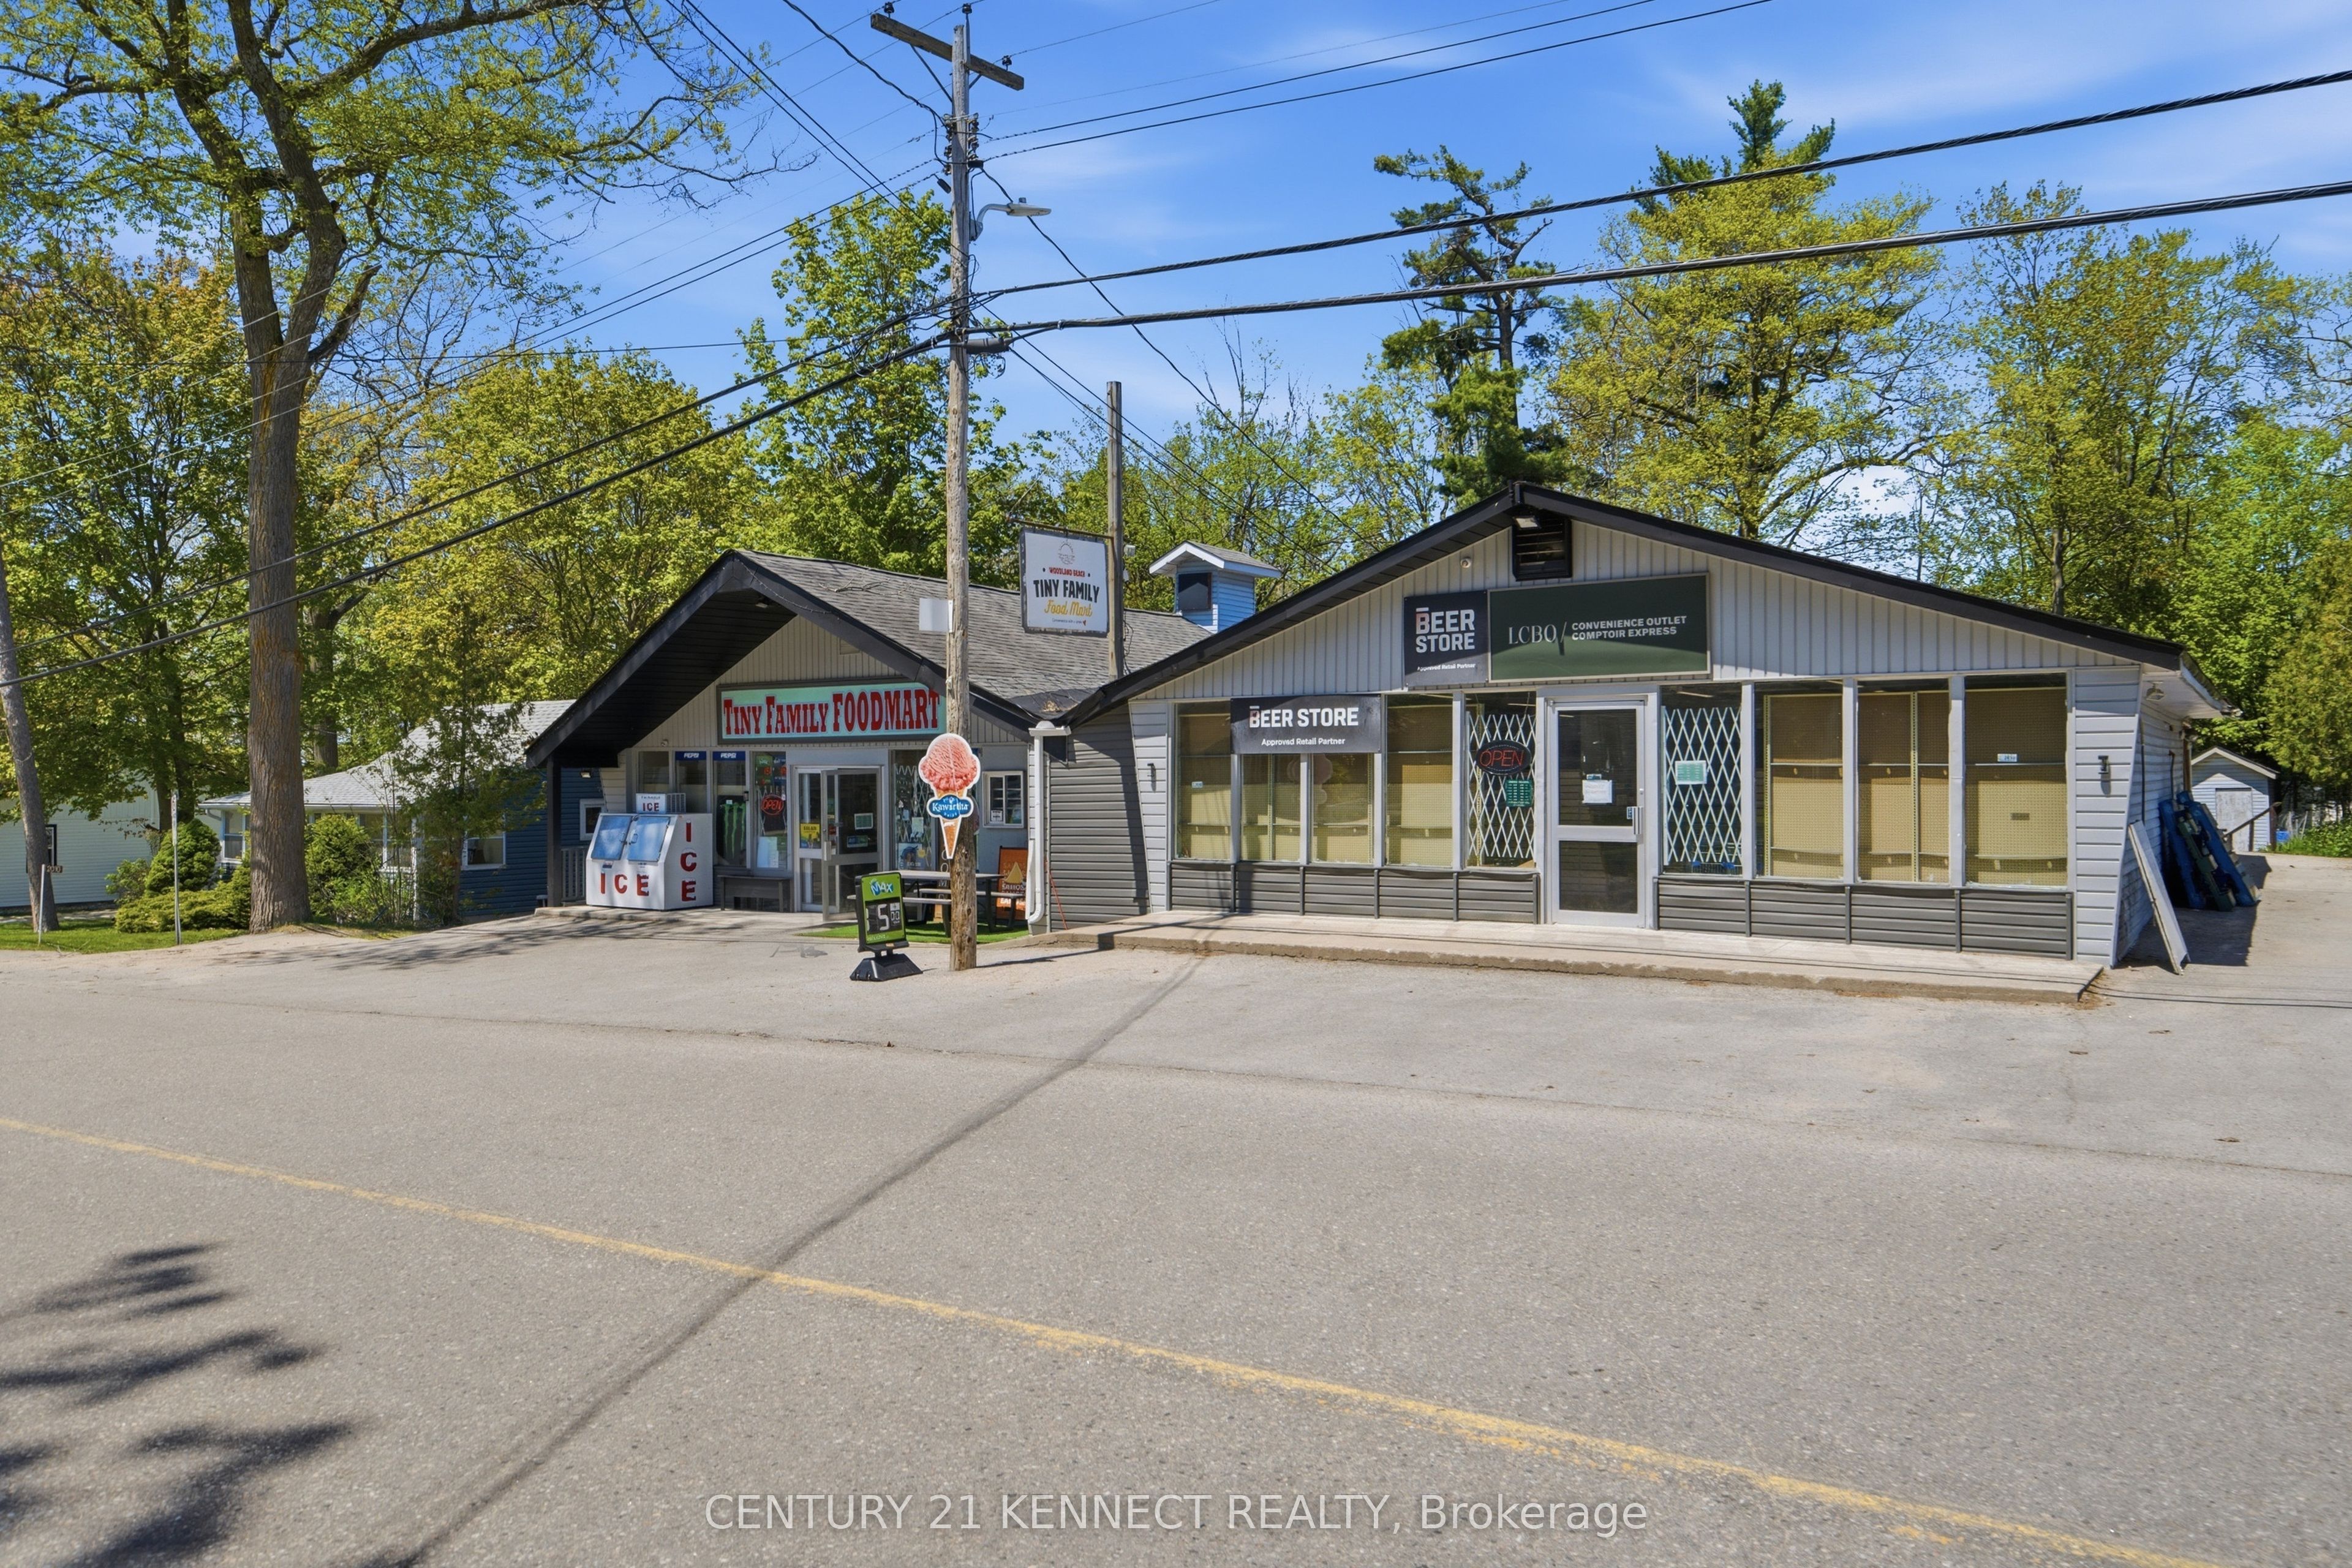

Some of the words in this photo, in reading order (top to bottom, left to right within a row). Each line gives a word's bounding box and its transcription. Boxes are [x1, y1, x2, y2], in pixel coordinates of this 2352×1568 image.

[1033, 579, 1059, 597] TINY
[1063, 580, 1099, 603] FAMILY
[1044, 600, 1068, 615] Food
[1069, 601, 1093, 617] Mart
[1416, 607, 1475, 635] BEER
[1572, 619, 1644, 630] CONVENIENCE
[1646, 616, 1687, 626] OUTLET
[1416, 633, 1475, 654] STORE
[1509, 624, 1556, 644] LCBO
[1572, 630, 1626, 640] COMPTOIR
[1628, 627, 1677, 637] EXPRESS
[723, 699, 762, 734] TINY
[766, 696, 828, 734] FAMILY
[832, 689, 940, 732] FOODMART
[1250, 706, 1293, 728] BEER
[1297, 707, 1359, 727] STORE
[1480, 750, 1524, 766] OPEN
[643, 802, 660, 812] ICE
[762, 799, 782, 810] OPEN
[680, 820, 696, 902] ICE
[601, 872, 649, 896] ICE
[871, 881, 893, 895] MAX
